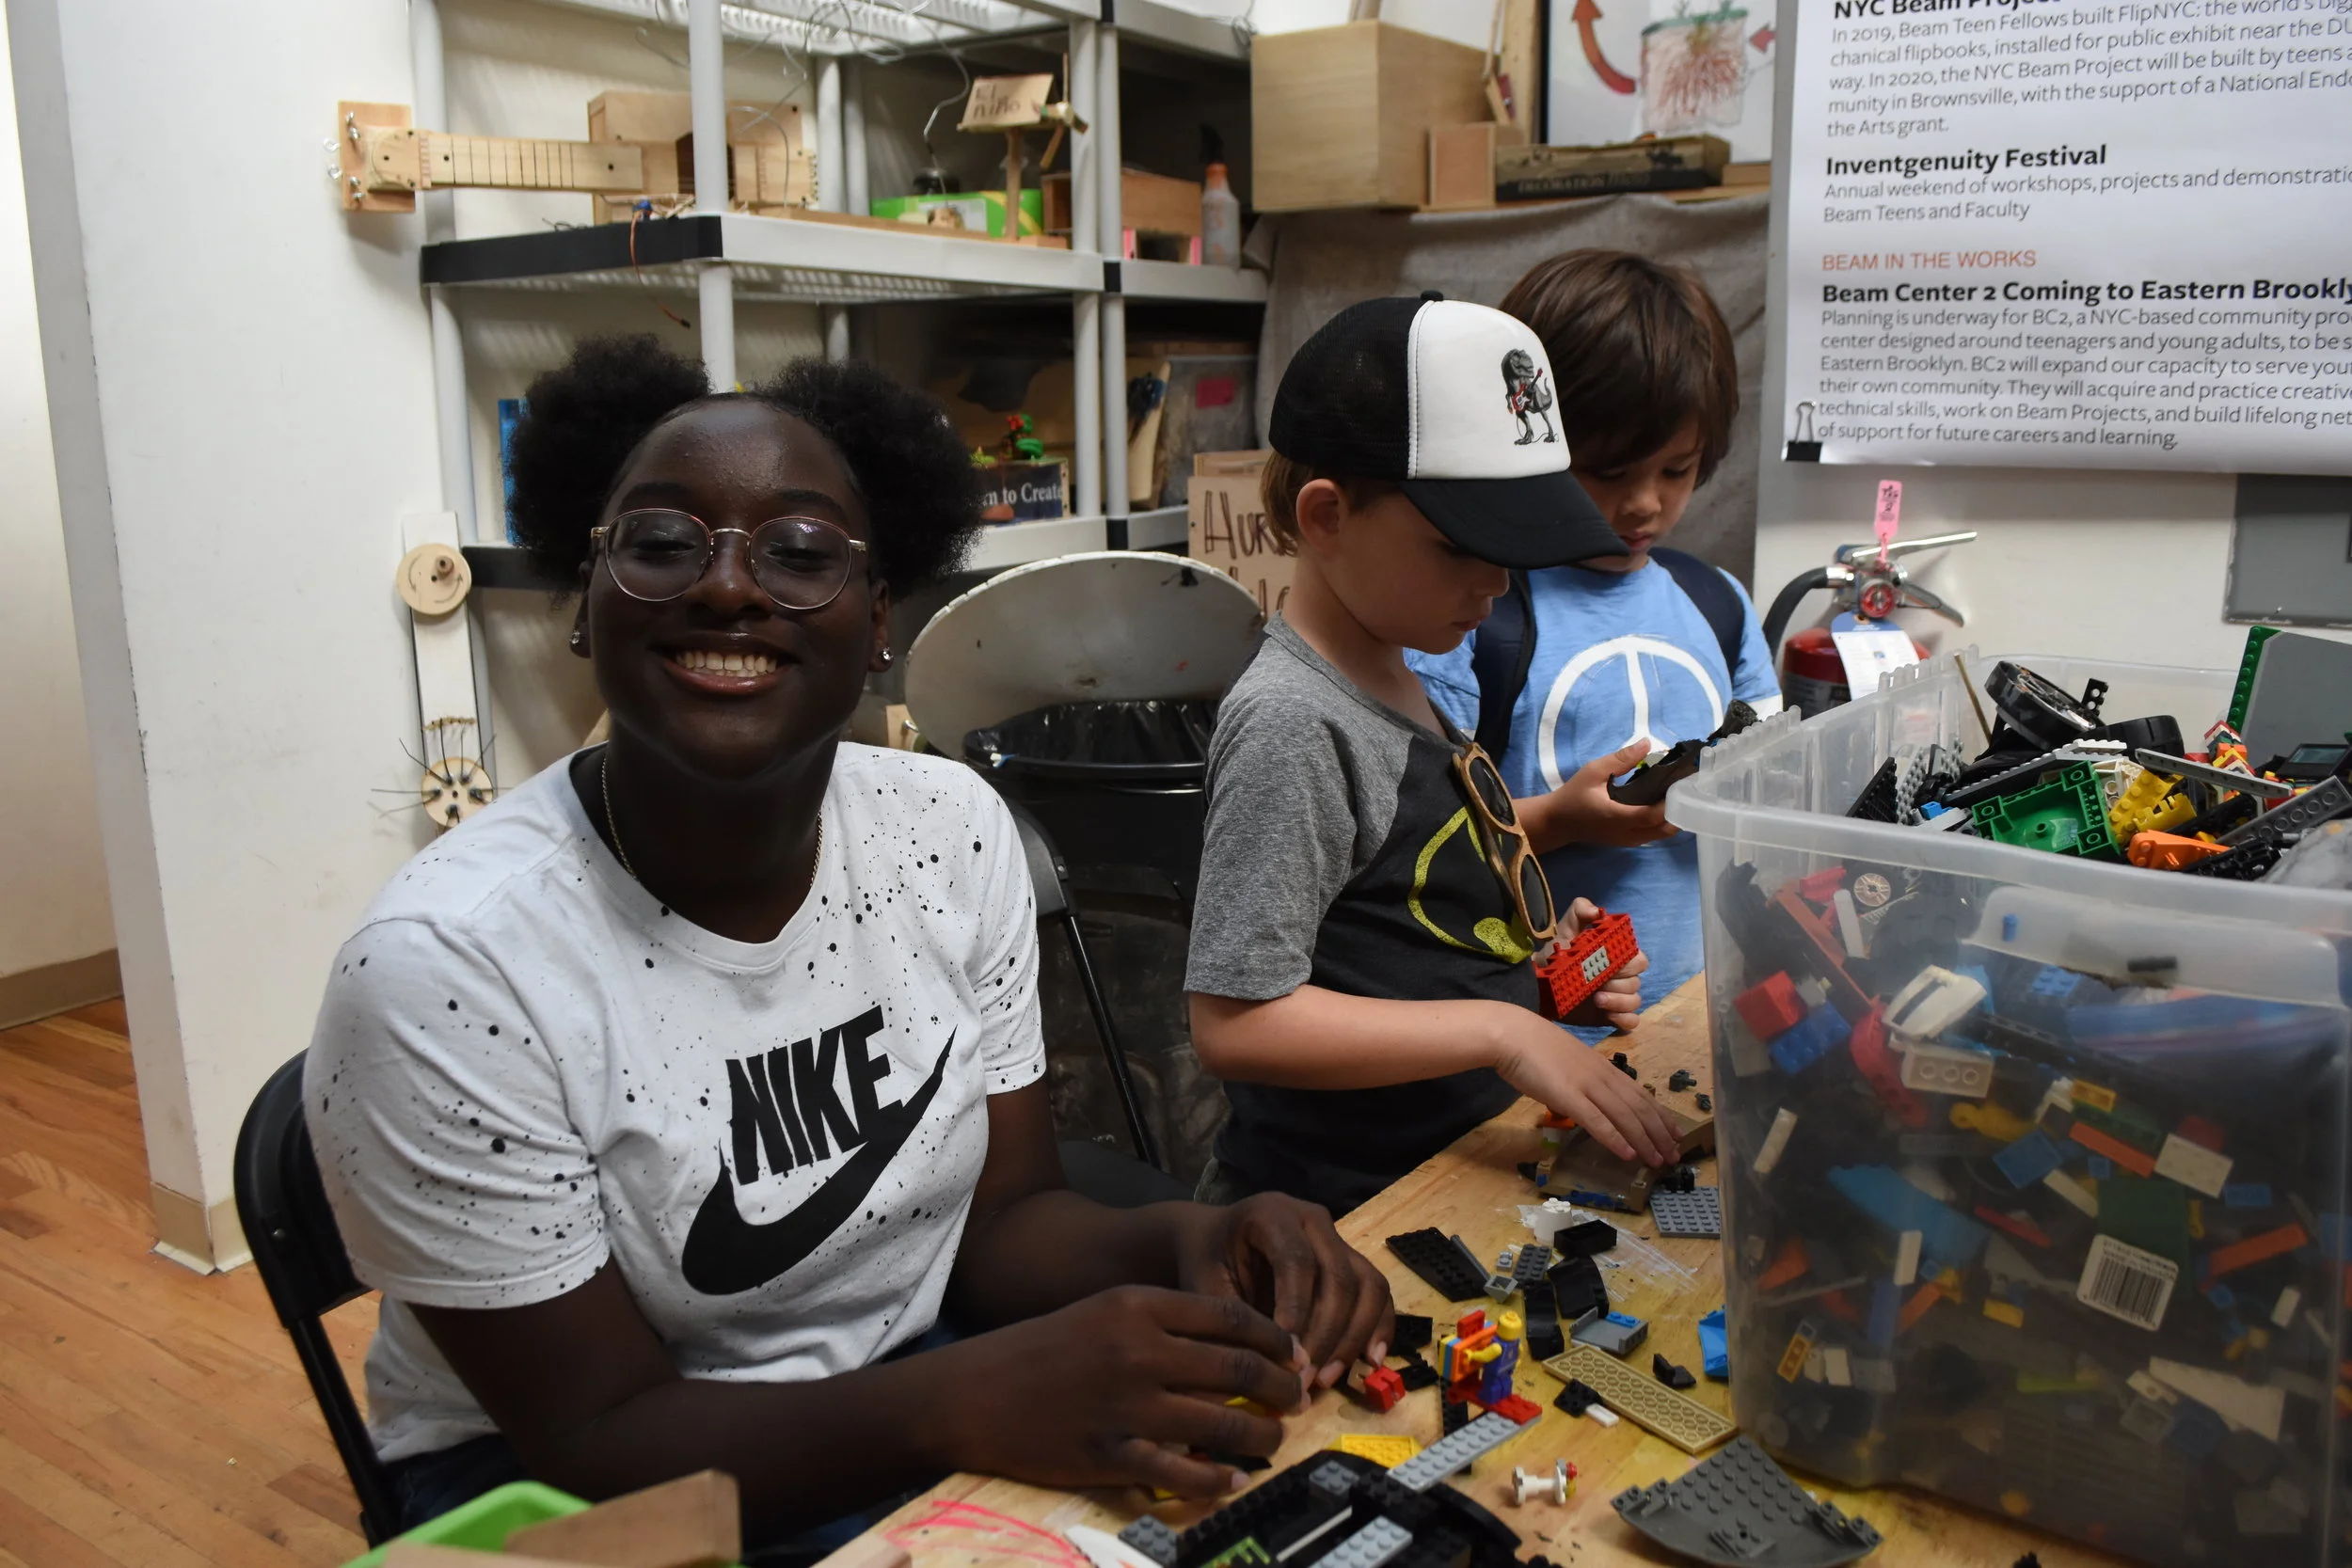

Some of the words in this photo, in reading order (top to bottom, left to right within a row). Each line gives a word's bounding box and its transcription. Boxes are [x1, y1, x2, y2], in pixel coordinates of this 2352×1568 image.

[1833, 28, 1847, 43] In
[1851, 27, 1895, 42] 2019,
[1899, 23, 1948, 38] Beam
[1953, 18, 1995, 33] Teen
[2000, 12, 2068, 30] Fellows
[2073, 7, 2114, 25] built
[2119, 0, 2201, 26] FlipNYC:
[2205, 0, 2238, 17] the
[1835, 0, 1883, 19] NYC
[1893, 0, 1961, 14] Beam
[1831, 45, 1900, 67] chanical
[1905, 40, 1991, 65] flipbooks,
[1995, 34, 2072, 55] installed
[2076, 32, 2106, 51] for
[2107, 27, 2166, 53] public
[2169, 24, 2236, 44] exhibit
[2240, 24, 2286, 40] near
[2290, 19, 2324, 38] the
[1830, 76, 1865, 93] way.
[1869, 72, 1884, 87] In
[1889, 71, 1937, 87] 2020,
[1941, 66, 1970, 83] the
[1975, 63, 2013, 80] NYC
[2019, 62, 2070, 78] Beam
[2074, 56, 2143, 78] Project
[2147, 52, 2179, 71] will
[2183, 51, 2207, 69] be
[2211, 48, 2255, 68] built
[2260, 47, 2284, 70] by
[2287, 47, 2344, 63] teens
[1829, 98, 1888, 116] munity
[1892, 94, 1907, 109] in
[1912, 87, 2017, 108] Brownsville,
[2022, 85, 2060, 102] with
[2065, 83, 2095, 100] the
[2100, 80, 2177, 102] support
[2181, 75, 2204, 94] of
[2204, 80, 2216, 93] a
[2220, 71, 2304, 92] National
[2310, 69, 2352, 87] End
[1828, 120, 1855, 137] the
[1859, 120, 1895, 135] Arts
[1898, 118, 1948, 138] grant.
[1827, 150, 1998, 178] Inventgenuity
[2006, 144, 2106, 167] Festival
[1825, 181, 1883, 198] Annual
[1887, 177, 1965, 197] weekend
[1969, 174, 1990, 194] of
[1992, 174, 2096, 195] workshops,
[2101, 174, 2179, 195] projects
[2183, 169, 2218, 187] and
[1824, 207, 1871, 222] Beam
[1875, 205, 1925, 220] Teens
[1929, 202, 1961, 219] and
[1965, 200, 2030, 222] Faculty
[1822, 254, 1878, 271] BEAM
[1885, 253, 1904, 269] IN
[1911, 252, 1950, 268] THE
[1958, 249, 2036, 268] WORKS
[1823, 285, 1888, 302] Beam
[1896, 283, 1978, 301] Center
[1984, 286, 1995, 300] 2
[2003, 280, 2101, 307] Coming
[2107, 283, 2134, 300] to
[2141, 281, 2245, 299] Eastern
[1821, 309, 1893, 330] Planning
[1897, 309, 1909, 325] is
[1913, 309, 1999, 330] underway
[2002, 308, 2029, 325] for
[2033, 309, 2073, 327] BC2,
[2076, 312, 2086, 325] a
[2089, 306, 2194, 325] NYC-based
[2199, 308, 2312, 329] community
[1821, 335, 1875, 349] center
[1879, 332, 1955, 354] designed
[1959, 332, 2022, 348] around
[2026, 335, 2116, 354] teenagers
[2120, 332, 2154, 349] and
[2156, 337, 2218, 355] young
[2221, 332, 2285, 353] adults,
[2290, 335, 2311, 349] to
[2314, 332, 2340, 349] be
[1821, 356, 1883, 371] Eastern
[1887, 355, 1967, 376] Brooklyn.
[1971, 356, 2006, 372] BC2
[2010, 356, 2038, 372] will
[2042, 356, 2107, 377] expand
[2111, 360, 2145, 373] our
[2148, 356, 2230, 379] capacity
[2232, 359, 2251, 373] to
[2256, 361, 2308, 374] serve
[1820, 378, 1859, 393] their
[1862, 382, 1898, 393] own
[1901, 379, 2002, 400] community.
[2007, 379, 2052, 401] They
[2054, 380, 2083, 396] will
[2087, 381, 2156, 402] acquire
[2160, 381, 2195, 398] and
[2199, 383, 2278, 403] practice
[1820, 401, 1893, 416] technical
[1897, 401, 1940, 420] skills,
[1944, 402, 1986, 418] work
[1990, 406, 2012, 419] on
[2017, 404, 2067, 420] Beam
[2072, 404, 2151, 425] Projects,
[2154, 405, 2190, 421] and
[2194, 405, 2241, 422] build
[2246, 405, 2318, 429] lifelong
[1818, 421, 1836, 438] of
[1838, 426, 1904, 442] support
[1907, 423, 1932, 439] for
[1936, 423, 1990, 441] future
[1994, 430, 2058, 443] careers
[2062, 428, 2096, 443] and
[1002, 486, 1017, 505] to
[1021, 483, 1063, 503] Create
[724, 1004, 902, 1186] NIKE
